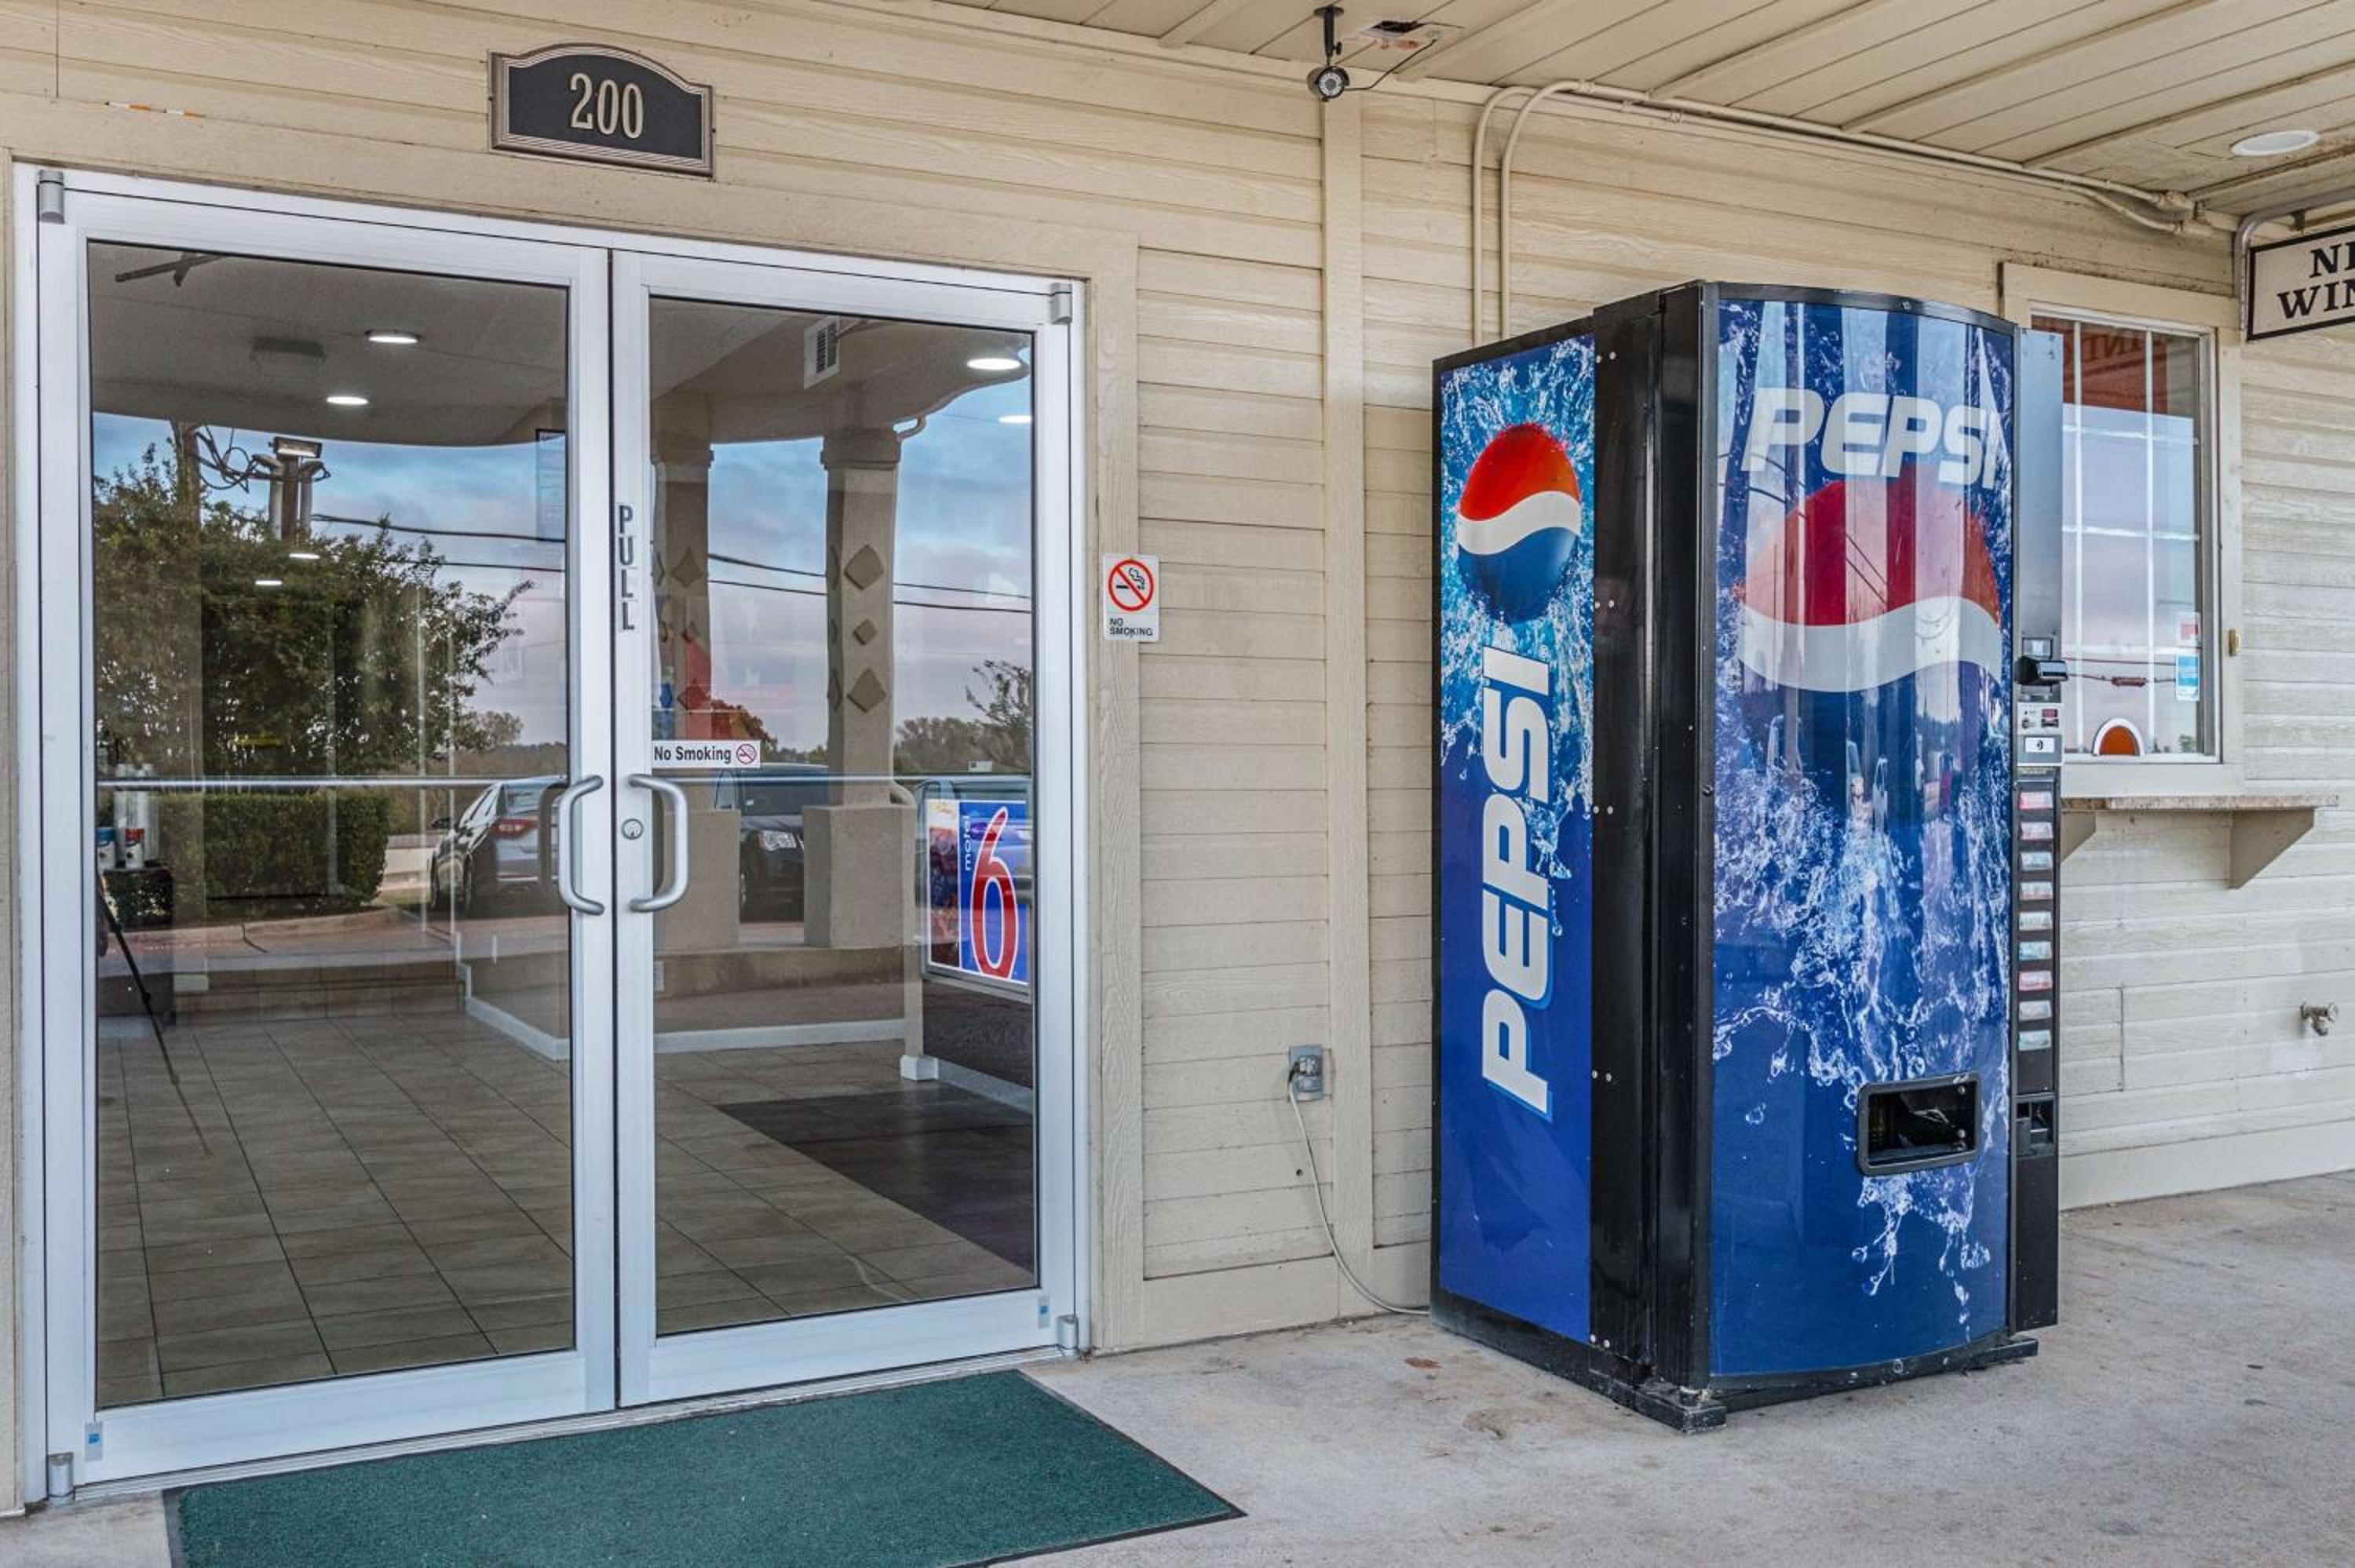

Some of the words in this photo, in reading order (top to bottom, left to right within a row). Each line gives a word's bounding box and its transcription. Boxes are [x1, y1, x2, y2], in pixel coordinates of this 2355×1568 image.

[569, 72, 644, 139] 200
[1740, 386, 2002, 490] PEPSI
[618, 504, 636, 631] PULL
[1109, 618, 1123, 627] NO
[1109, 627, 1153, 636] SMOKING
[654, 746, 671, 760] No
[675, 746, 732, 764] Smoking
[962, 815, 972, 871] motel
[970, 806, 1019, 979] 6
[1481, 644, 1551, 1116] PEPSI
